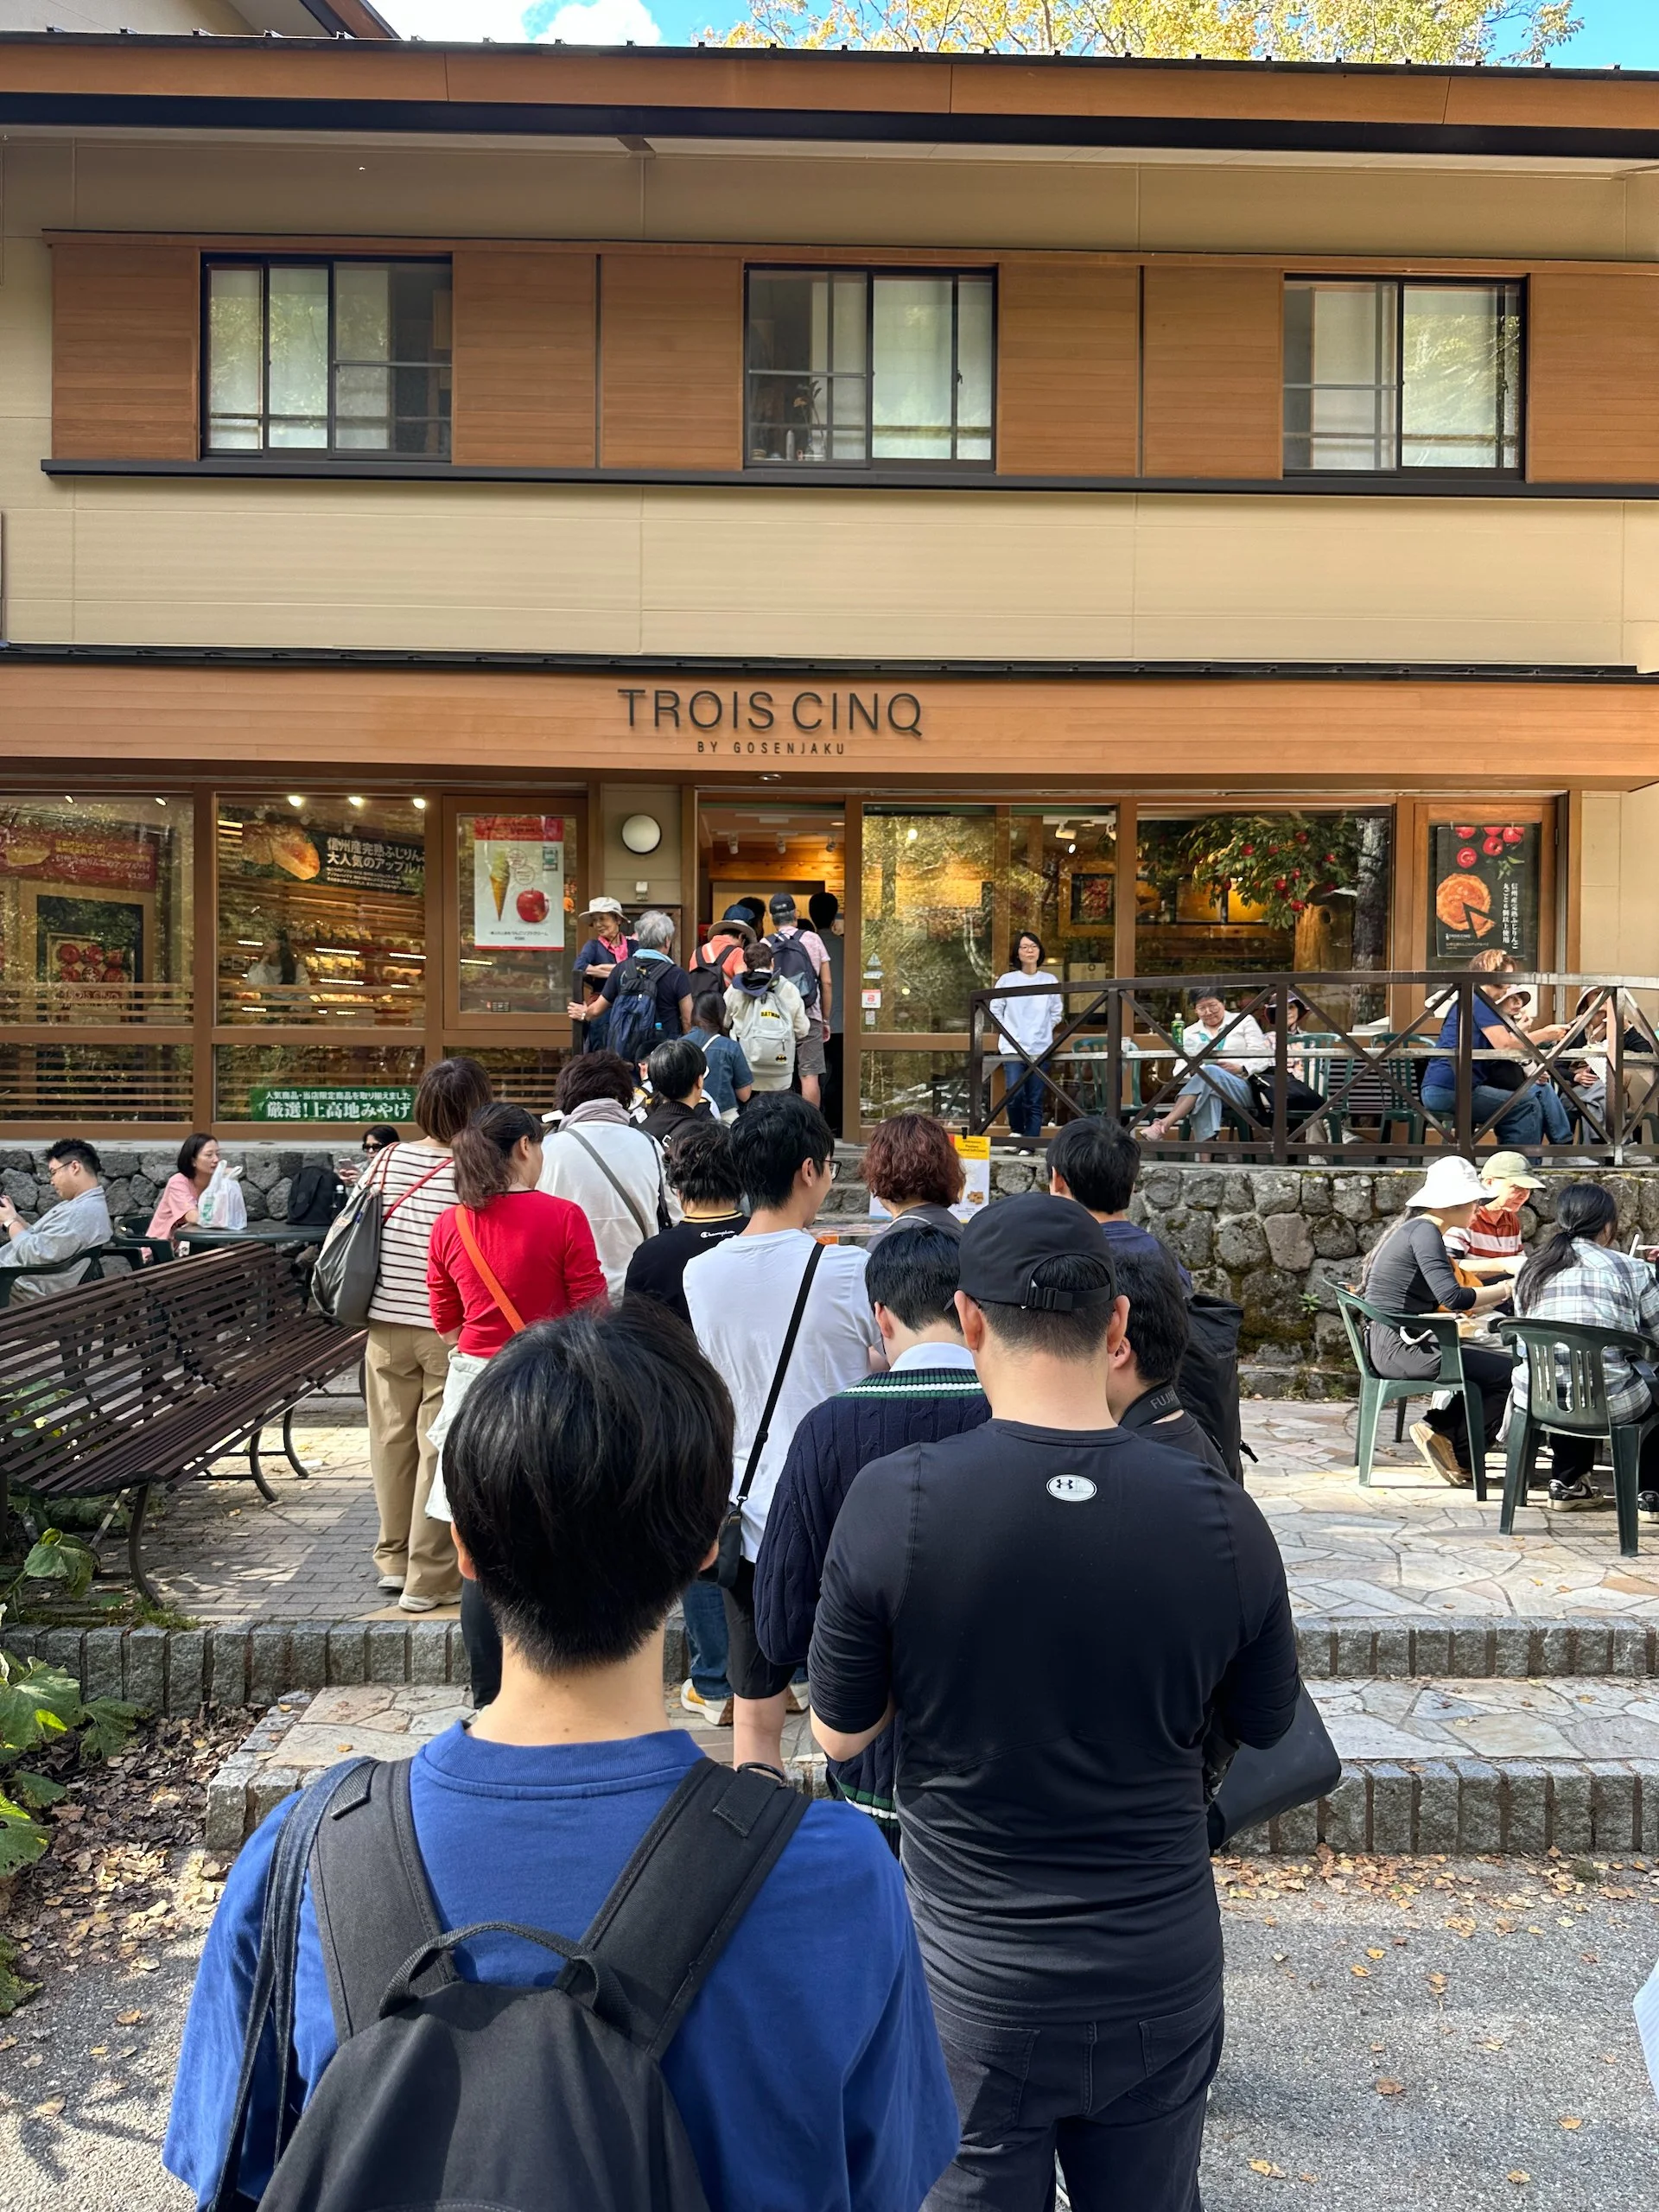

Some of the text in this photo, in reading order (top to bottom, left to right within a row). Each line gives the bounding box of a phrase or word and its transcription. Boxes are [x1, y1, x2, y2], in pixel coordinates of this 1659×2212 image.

[618, 689, 924, 737] TROIS CINQ
[697, 741, 846, 755] BY GOSENJAKU
[700, 1230, 735, 1238] Champion
